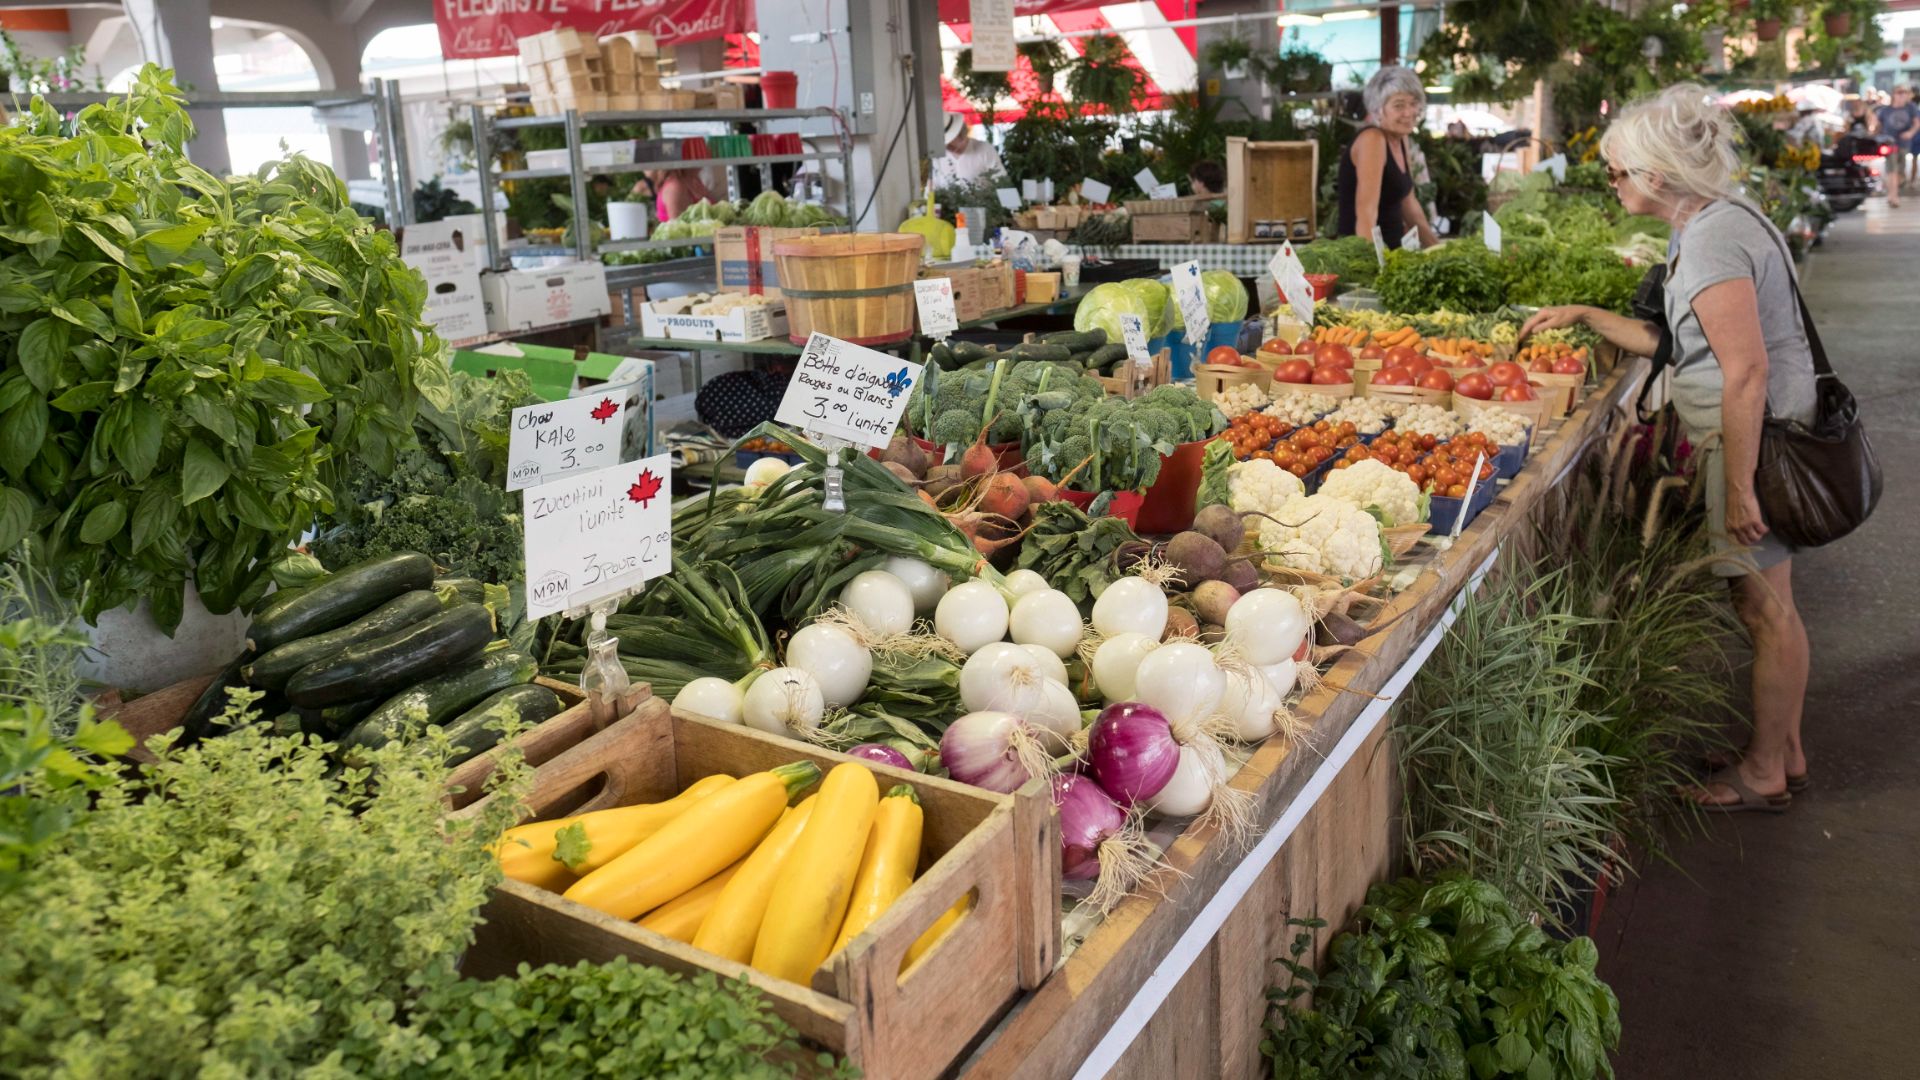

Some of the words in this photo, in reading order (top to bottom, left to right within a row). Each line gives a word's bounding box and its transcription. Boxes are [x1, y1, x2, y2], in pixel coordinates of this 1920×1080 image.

[648, 0, 729, 39] Daniel
[667, 317, 715, 328] PRODUITS
[803, 352, 840, 375] Botte
[798, 372, 832, 391] Rouges
[837, 386, 849, 396] ou
[853, 386, 894, 410] Blancs
[847, 411, 894, 435] l'unité
[560, 443, 604, 470] 3.00
[512, 466, 540, 479] MPM
[579, 497, 625, 533] l'unité
[533, 578, 569, 601] MPM
